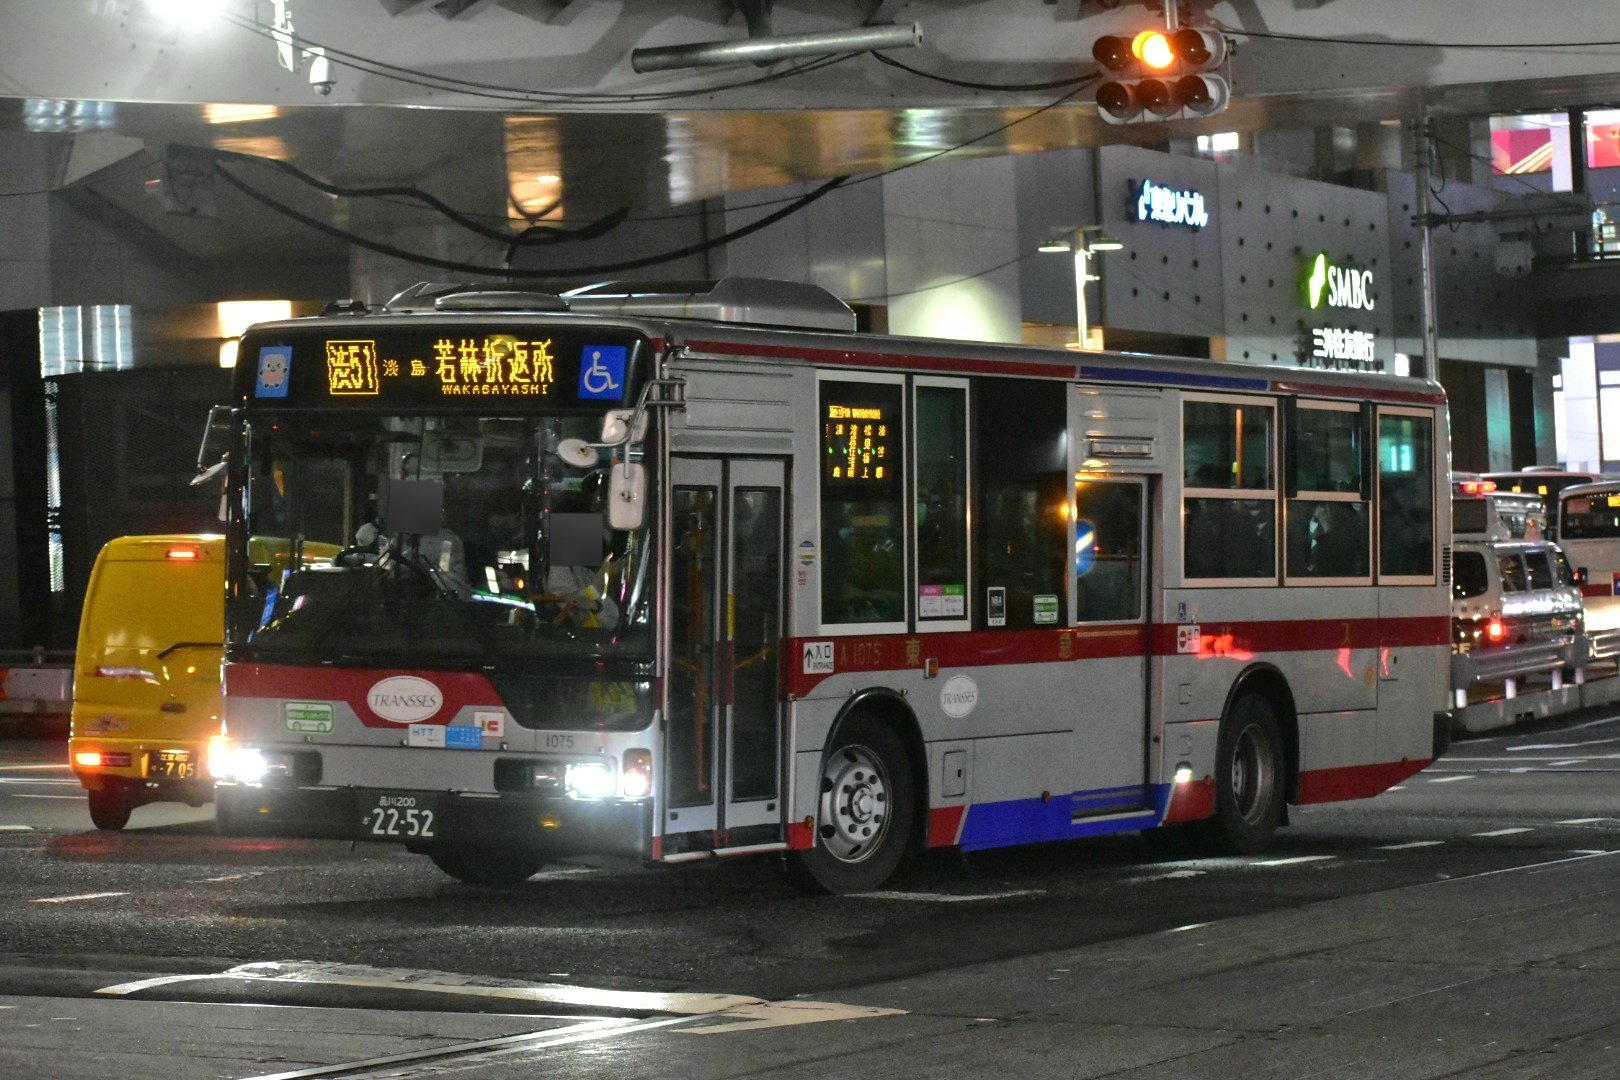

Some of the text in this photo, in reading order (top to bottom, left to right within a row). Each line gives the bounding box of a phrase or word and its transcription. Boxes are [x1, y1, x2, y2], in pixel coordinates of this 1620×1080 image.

[1328, 265, 1374, 311] SMBC
[1313, 328, 1375, 362] 三井住友銀行
[433, 338, 554, 383] 若林折返所
[815, 644, 831, 660] 入口
[853, 642, 881, 666] 1075
[371, 694, 438, 708] TRANSSES
[546, 734, 574, 749] 1075
[372, 807, 434, 837] 22-52
